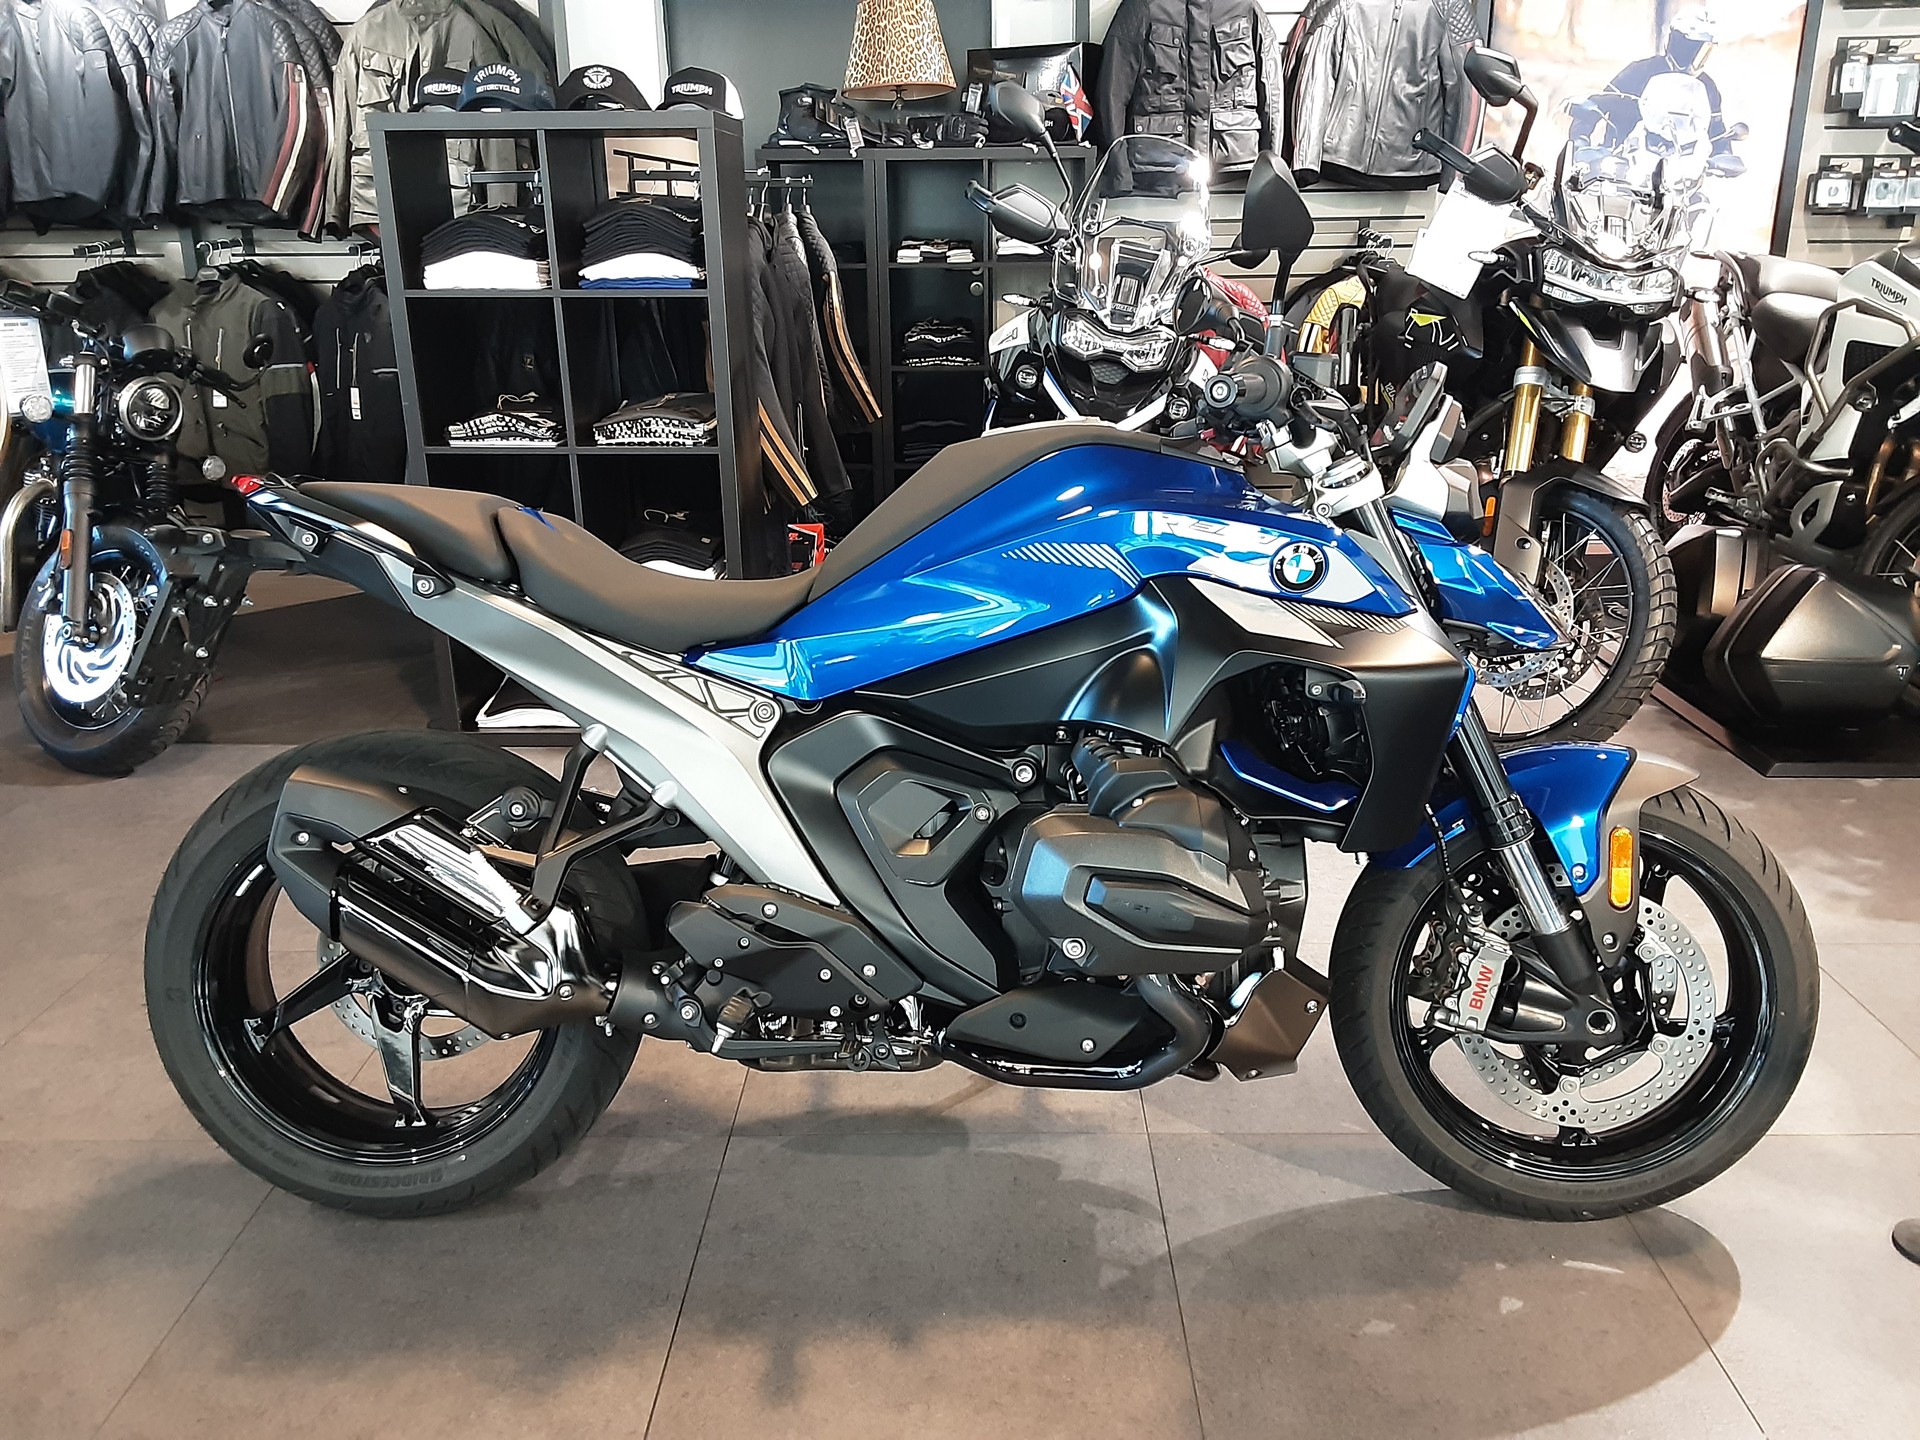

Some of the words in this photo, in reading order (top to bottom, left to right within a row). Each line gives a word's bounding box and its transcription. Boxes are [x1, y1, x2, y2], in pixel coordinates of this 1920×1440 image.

[473, 64, 521, 84] TRIUMPH
[476, 83, 520, 95] MOTORCYCLES
[671, 83, 713, 95] TRIUMPH
[1871, 277, 1908, 306] TRIUMPH
[1276, 545, 1323, 570] BMW
[1468, 964, 1494, 1011] BMW
